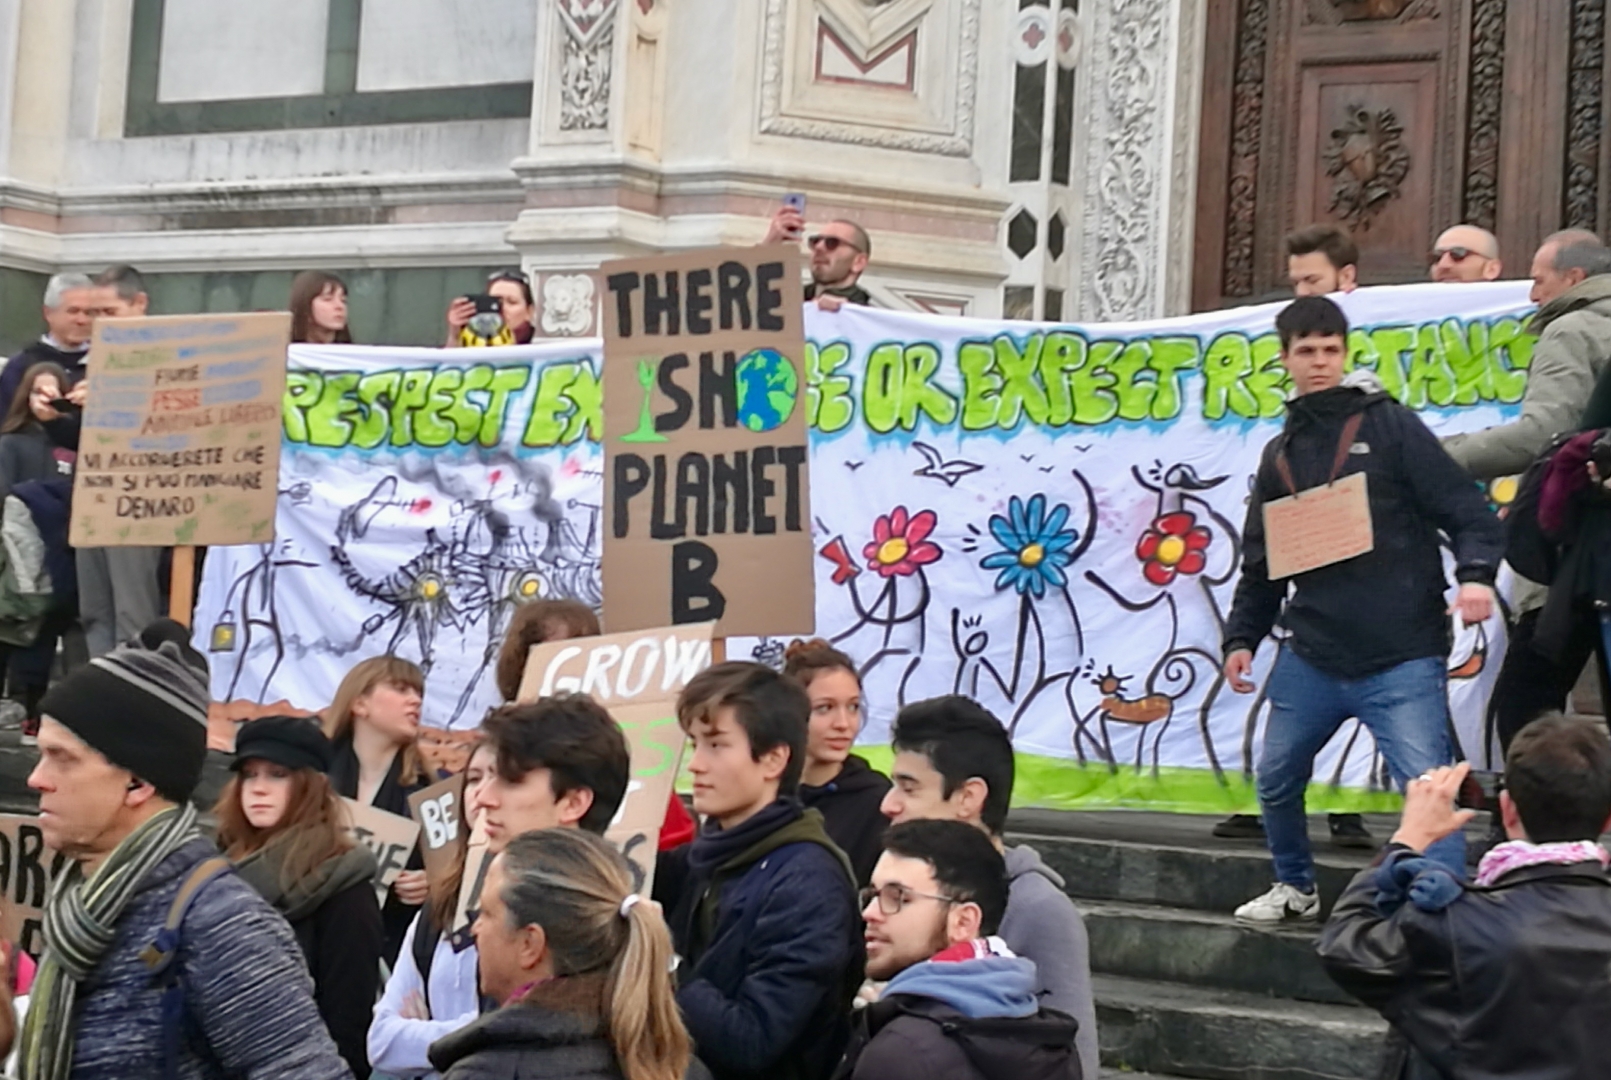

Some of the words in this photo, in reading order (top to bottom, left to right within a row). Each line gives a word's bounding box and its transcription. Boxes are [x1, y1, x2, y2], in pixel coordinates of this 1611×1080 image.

[607, 261, 784, 338] THERE
[282, 363, 531, 448] RESPECT
[862, 340, 959, 434] OR
[957, 330, 1201, 430] EXPECT
[84, 452, 101, 468] VI
[232, 444, 265, 464] CHE
[116, 494, 195, 520] DENARO
[614, 446, 807, 539] PLANET
[672, 540, 726, 625] B
[537, 634, 712, 700] GROW
[420, 791, 458, 849] BE
